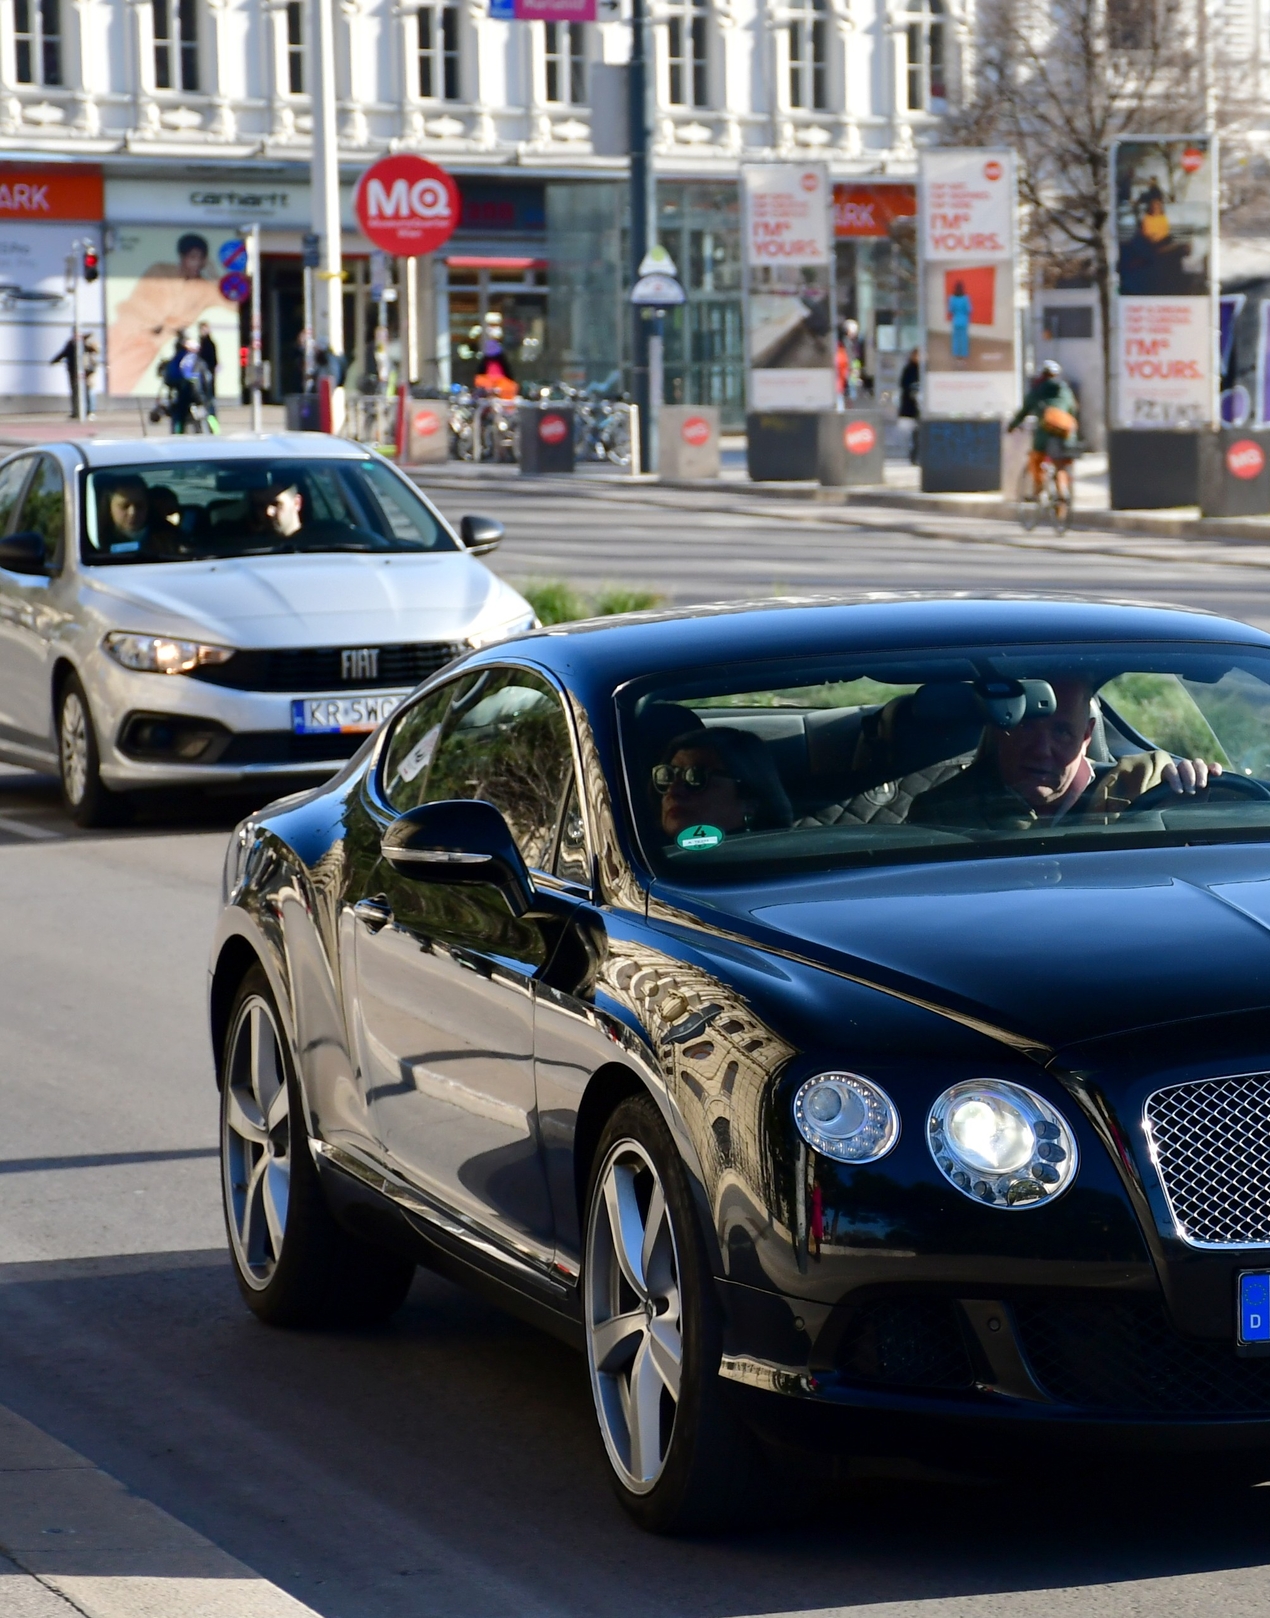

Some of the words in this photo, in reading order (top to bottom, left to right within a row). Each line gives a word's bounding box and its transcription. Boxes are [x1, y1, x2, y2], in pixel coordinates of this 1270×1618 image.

[367, 178, 451, 218] MQ
[1125, 360, 1204, 379] YOURS.
[341, 648, 380, 680] FIAT
[310, 700, 340, 726] KR
[1250, 1314, 1260, 1329] D
